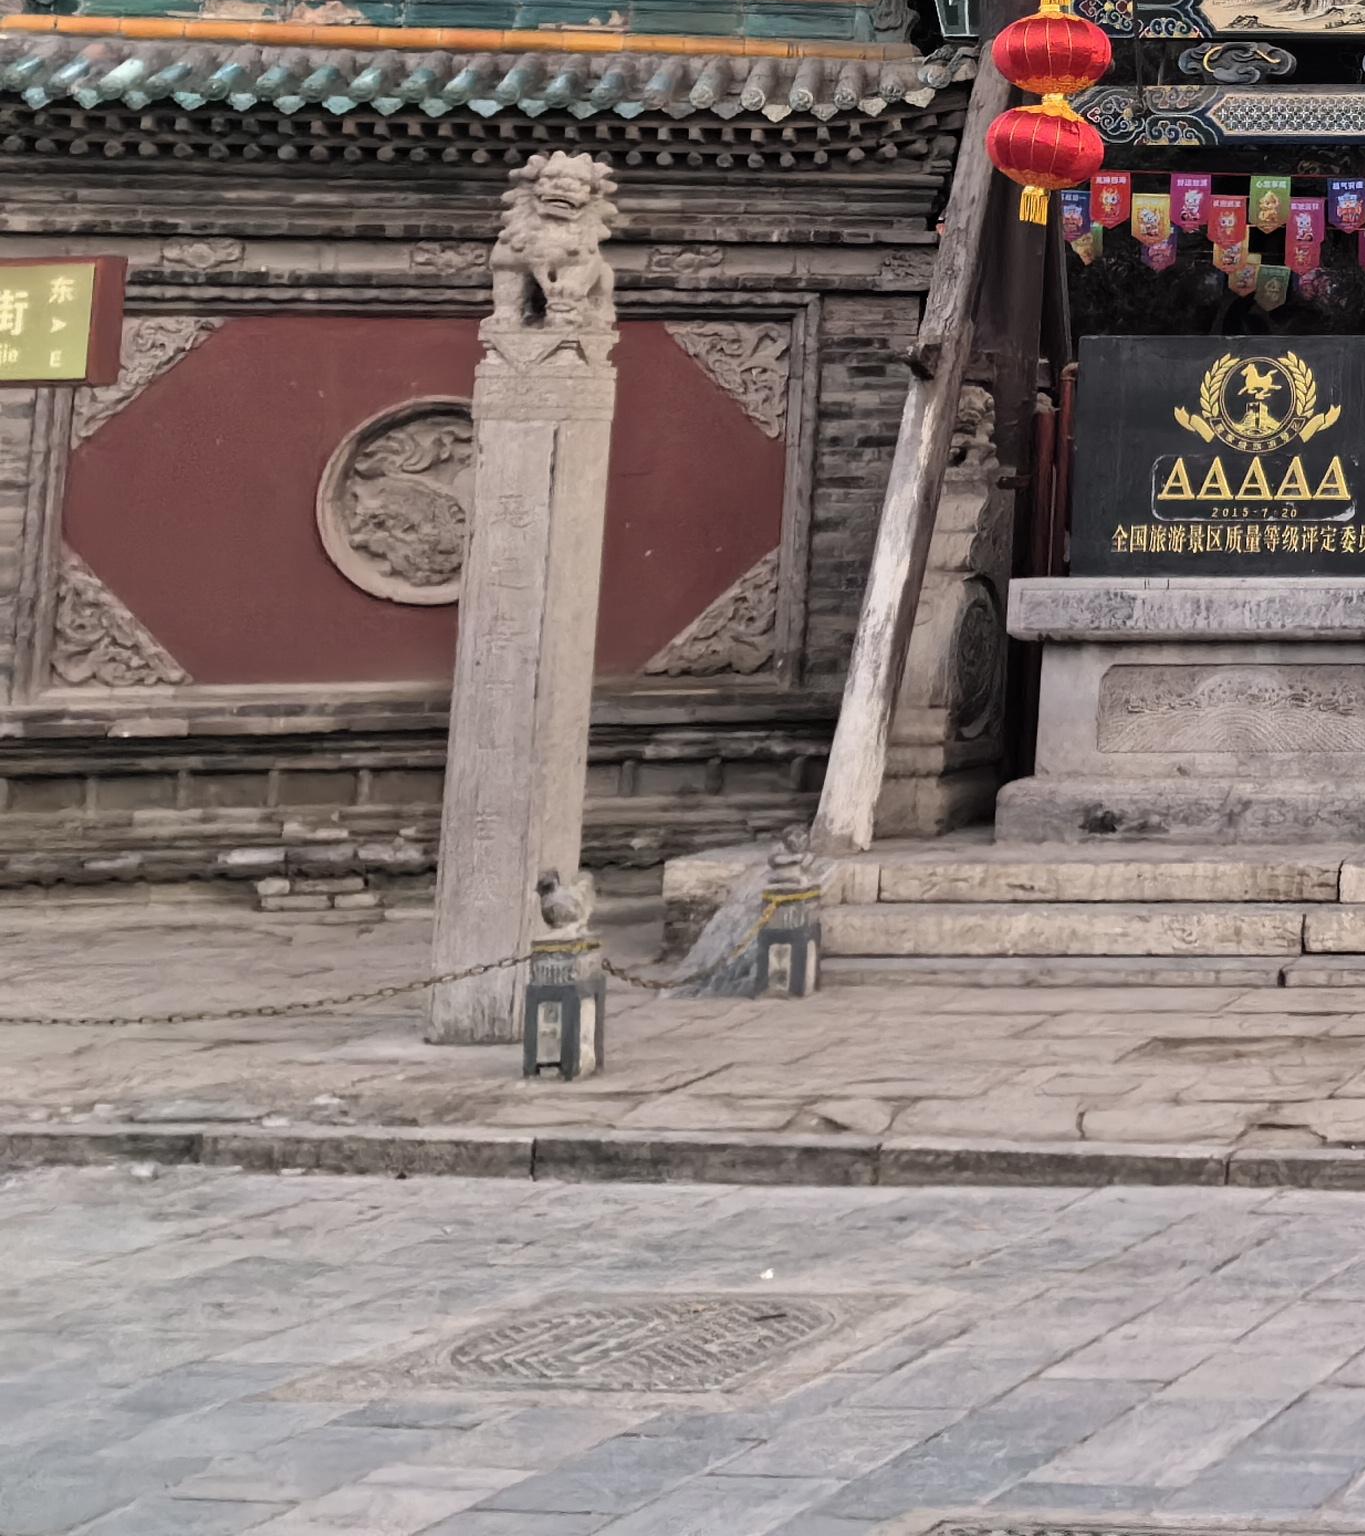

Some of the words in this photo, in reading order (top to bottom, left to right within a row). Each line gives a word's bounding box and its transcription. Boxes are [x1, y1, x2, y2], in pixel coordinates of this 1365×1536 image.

[48, 276, 76, 304] 东
[49, 350, 63, 368] E
[1157, 456, 1352, 501] AAAAA
